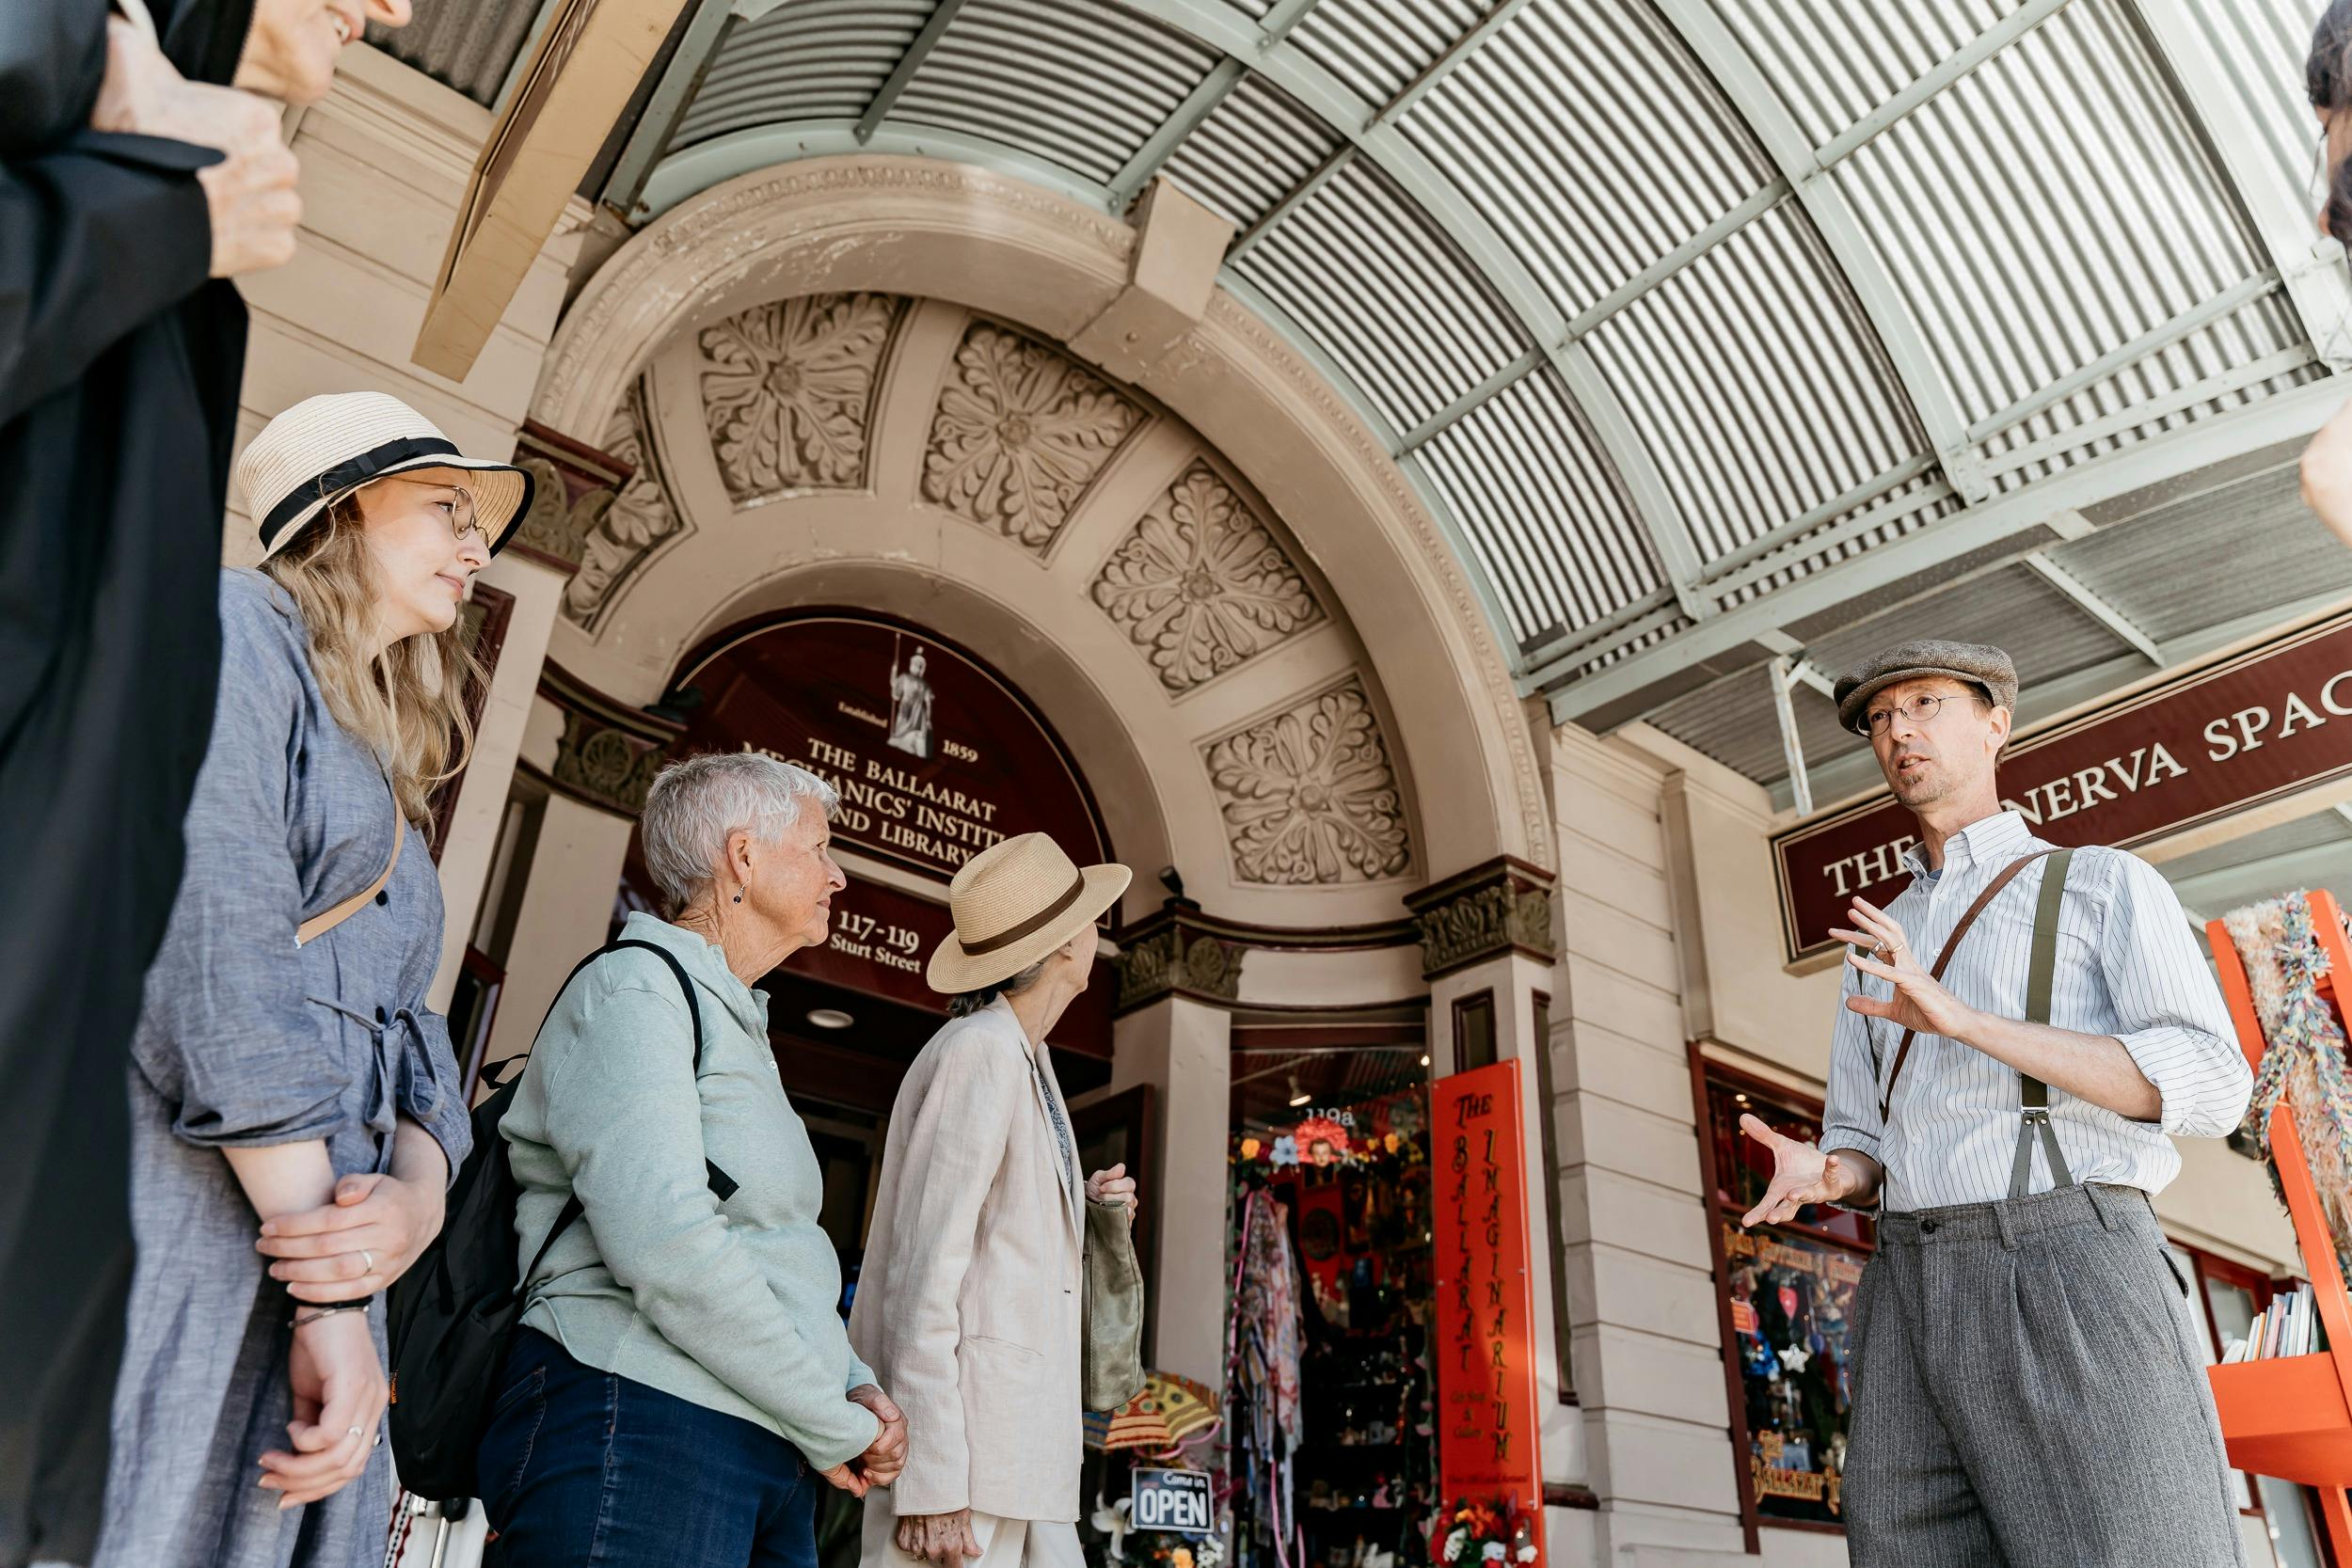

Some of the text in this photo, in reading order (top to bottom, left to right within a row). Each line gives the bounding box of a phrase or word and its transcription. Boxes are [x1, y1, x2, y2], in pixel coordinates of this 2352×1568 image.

[943, 738, 979, 764] 1859
[742, 741, 1006, 848] ANICS' INSTIT
[807, 737, 997, 822] THE BALLAARAT
[2000, 742, 2188, 826] NERVA
[834, 805, 975, 865] ND LIBRARY
[830, 932, 922, 974] Sturt Street
[837, 911, 920, 955] 117-119
[1139, 1487, 1207, 1528] OPEN
